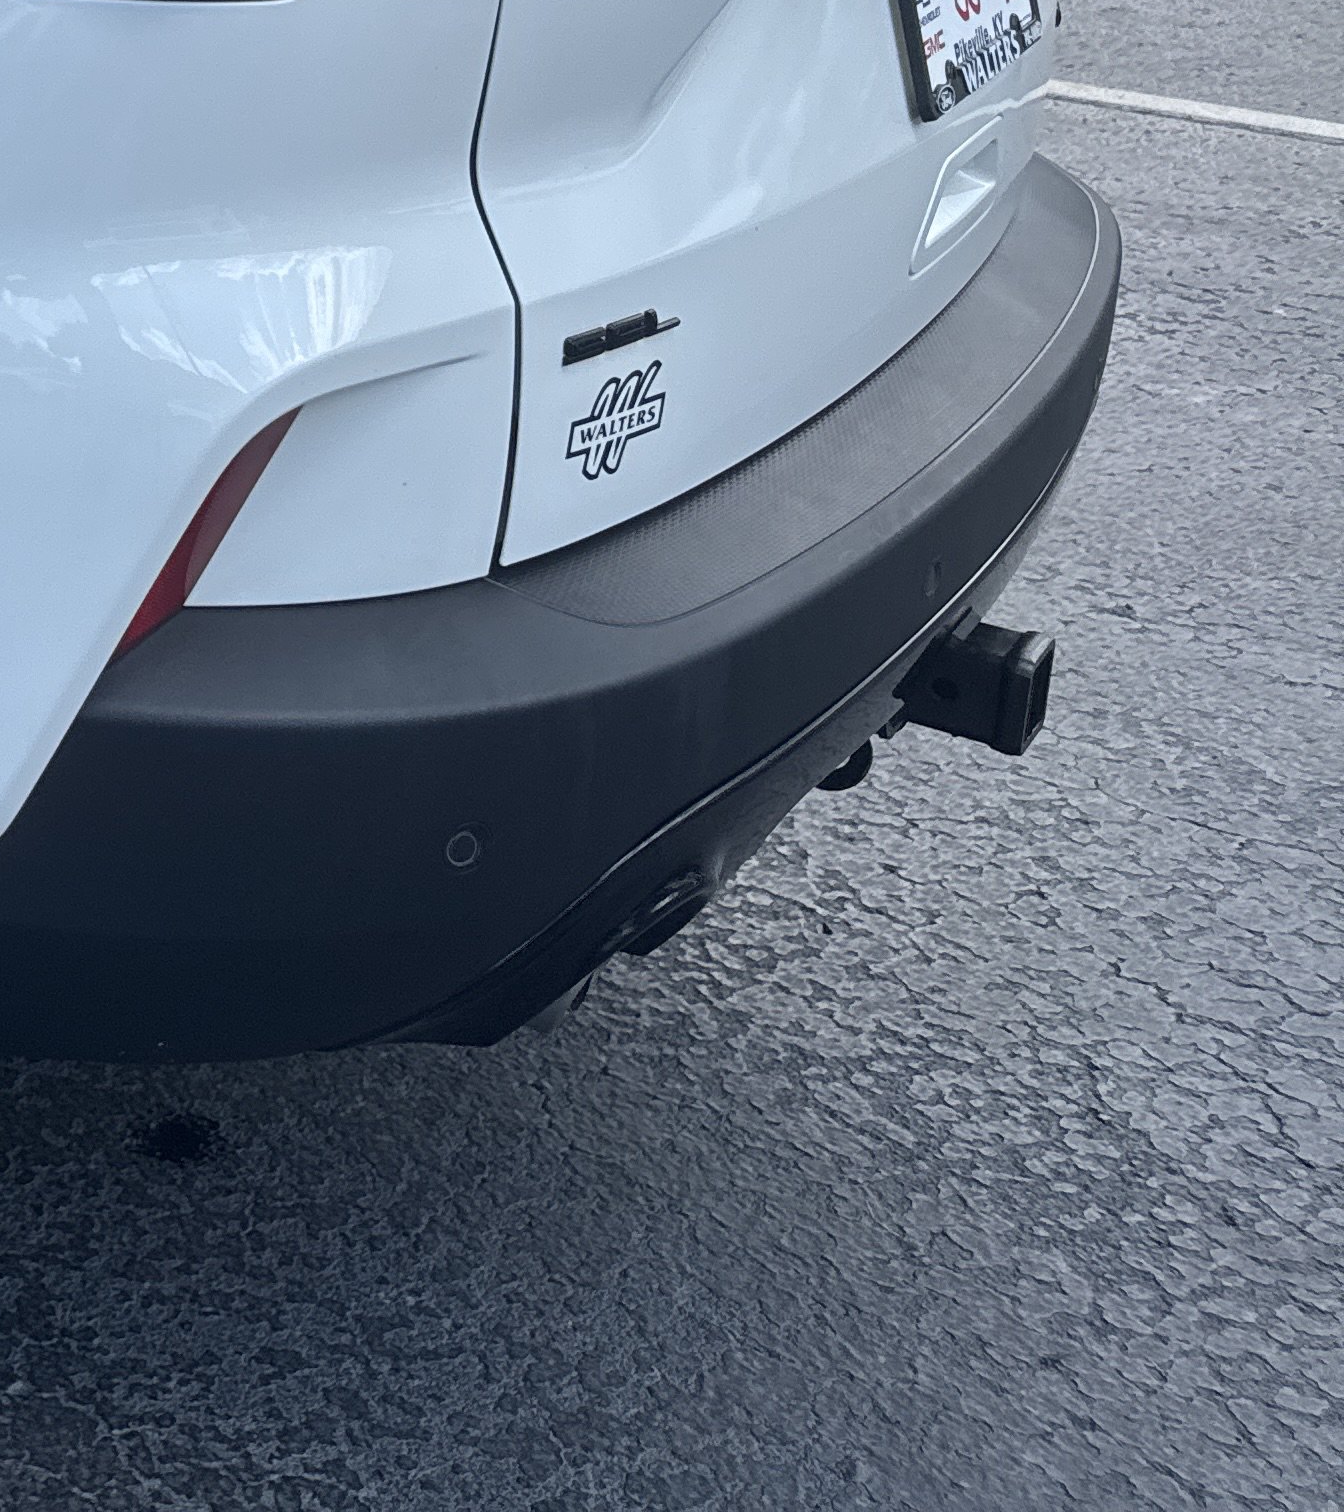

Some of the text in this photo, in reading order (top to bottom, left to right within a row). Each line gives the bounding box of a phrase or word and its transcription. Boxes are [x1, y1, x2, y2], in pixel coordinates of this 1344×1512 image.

[992, 10, 1004, 37] KY
[962, 30, 1021, 94] WALTERS
[579, 405, 657, 444] WALTERS
